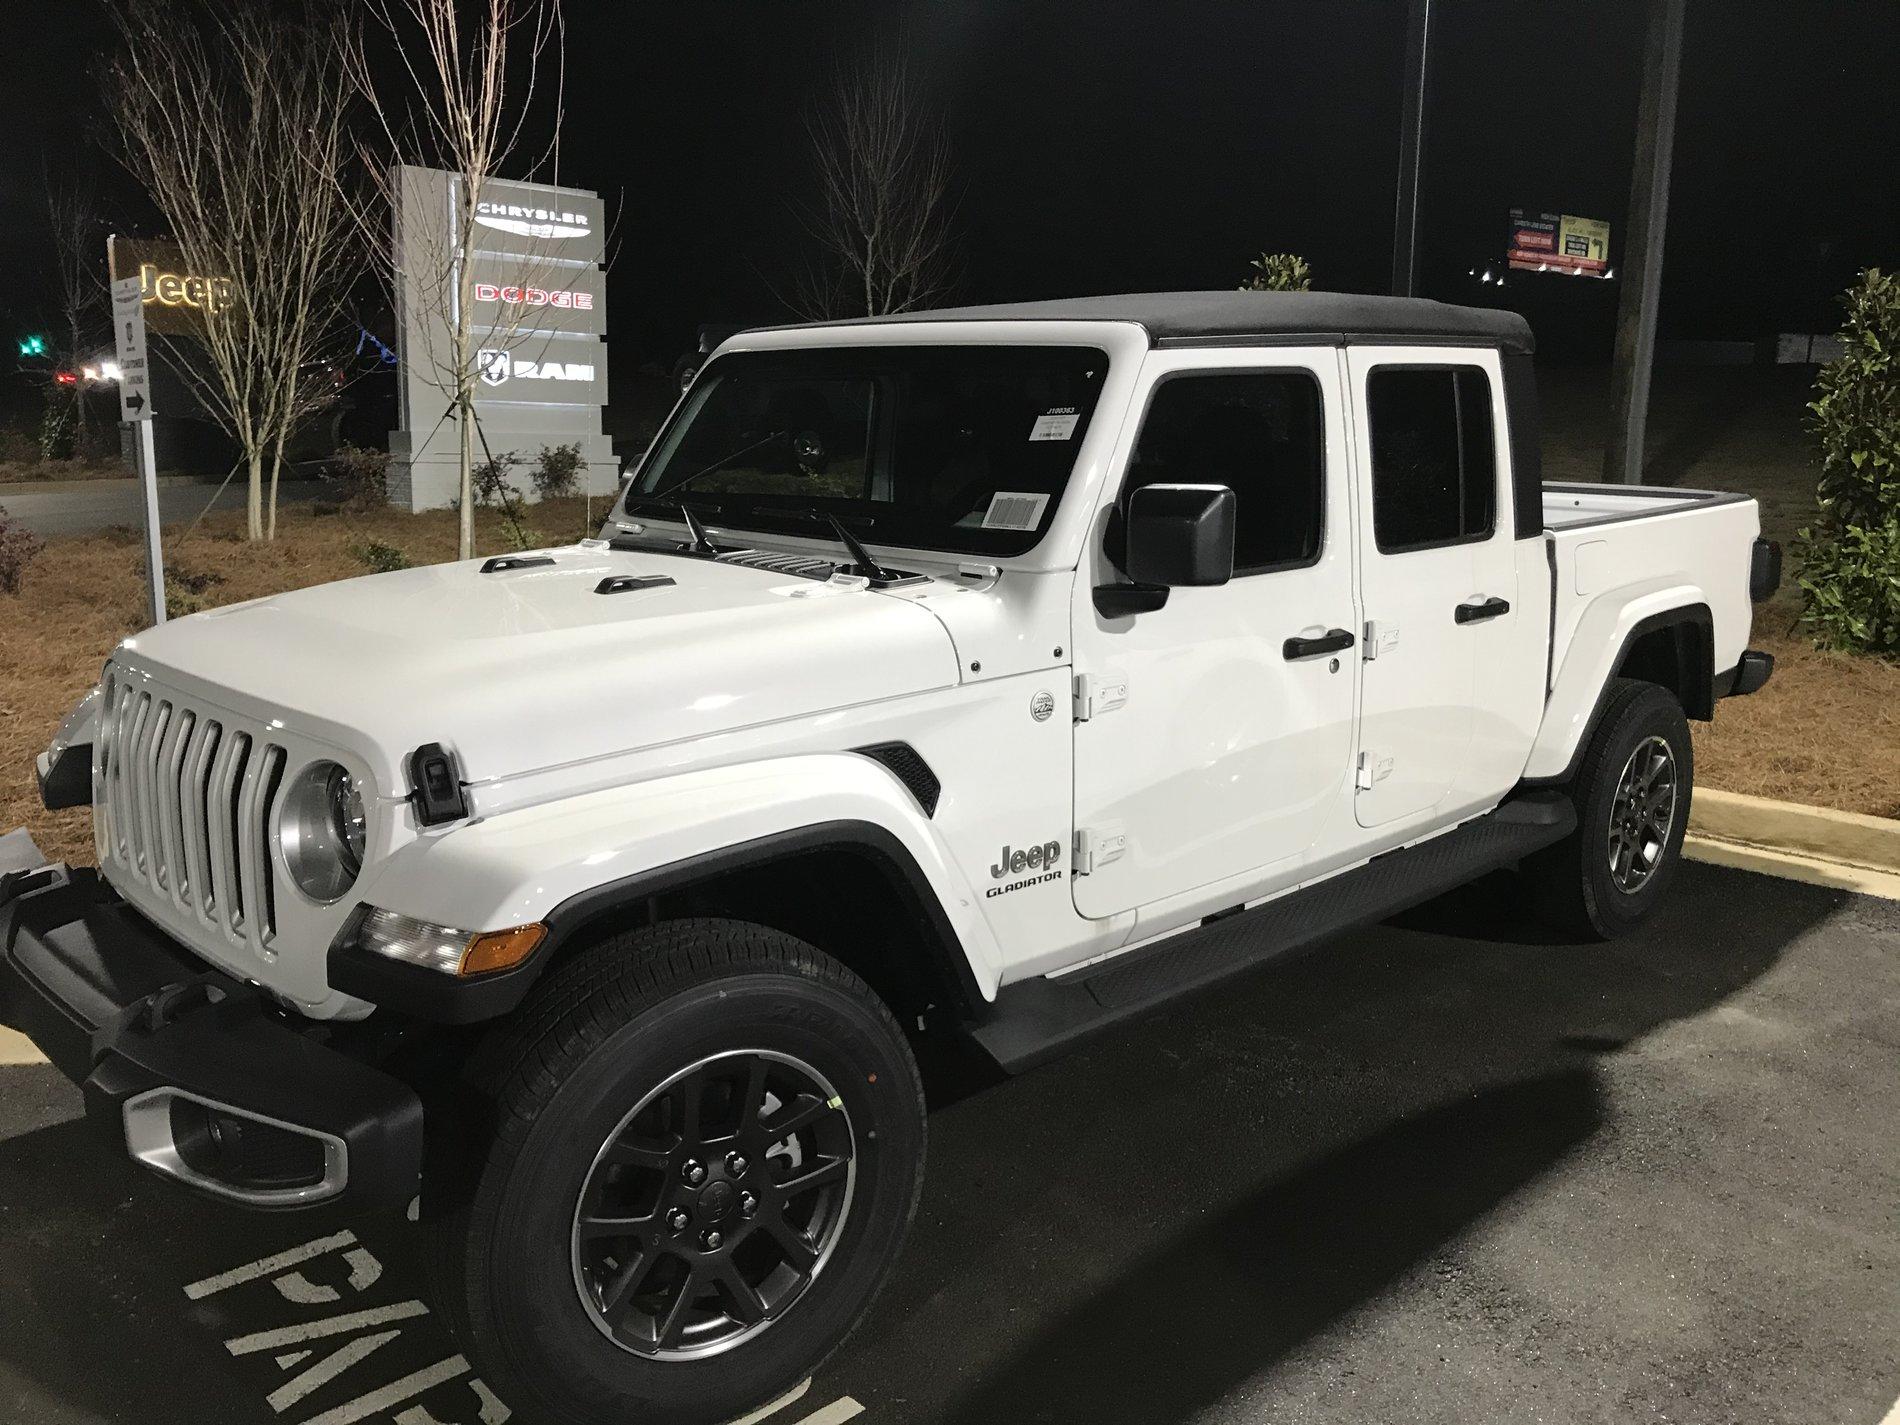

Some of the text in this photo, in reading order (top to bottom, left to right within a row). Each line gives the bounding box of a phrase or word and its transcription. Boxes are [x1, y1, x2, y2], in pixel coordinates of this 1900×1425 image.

[477, 202, 588, 225] CHRYSLER
[139, 263, 234, 315] Jeep
[475, 283, 593, 310] DODGE
[513, 361, 594, 381] RAM
[991, 841, 1060, 879] Jeep
[986, 871, 1062, 898] GLADIATOR
